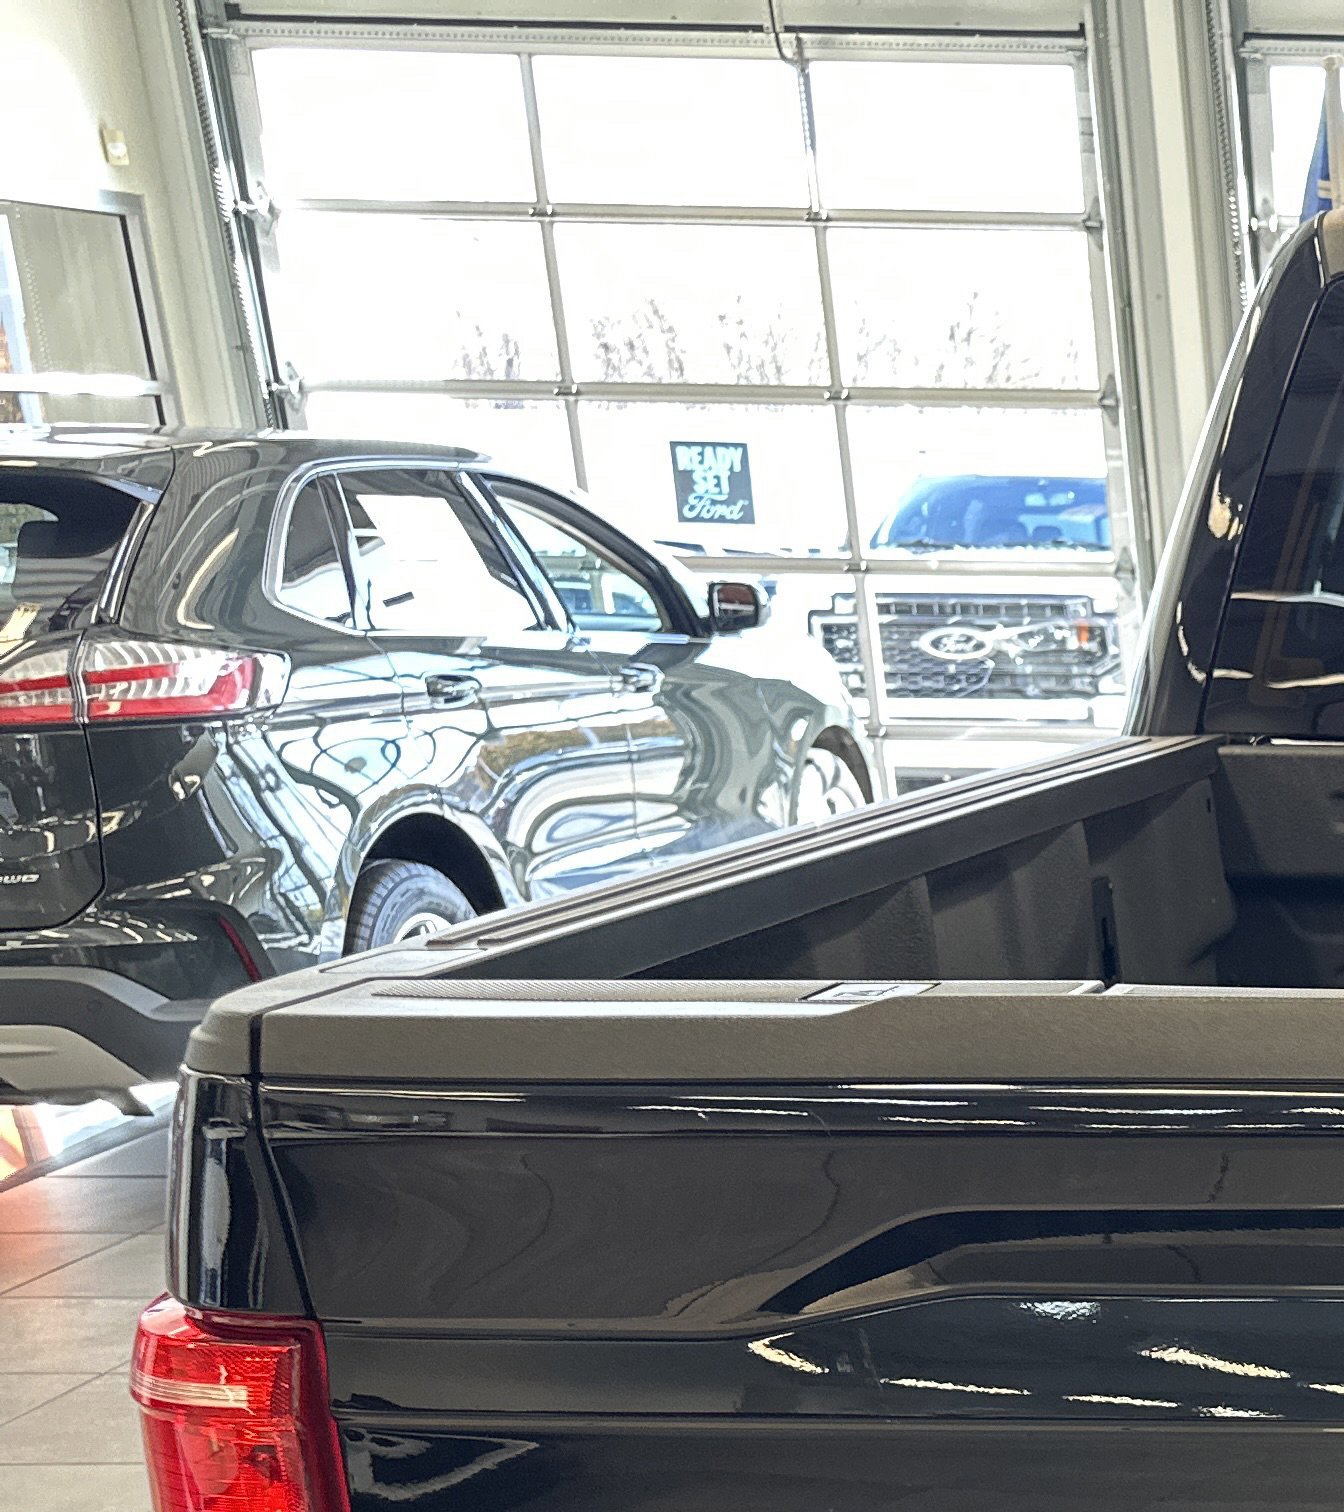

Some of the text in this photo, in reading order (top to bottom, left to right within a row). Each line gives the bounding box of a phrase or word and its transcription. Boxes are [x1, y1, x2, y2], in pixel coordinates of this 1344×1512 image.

[675, 445, 743, 472] READY
[692, 469, 730, 494] SET
[683, 493, 746, 520] Ford
[0, 874, 40, 884] WD
